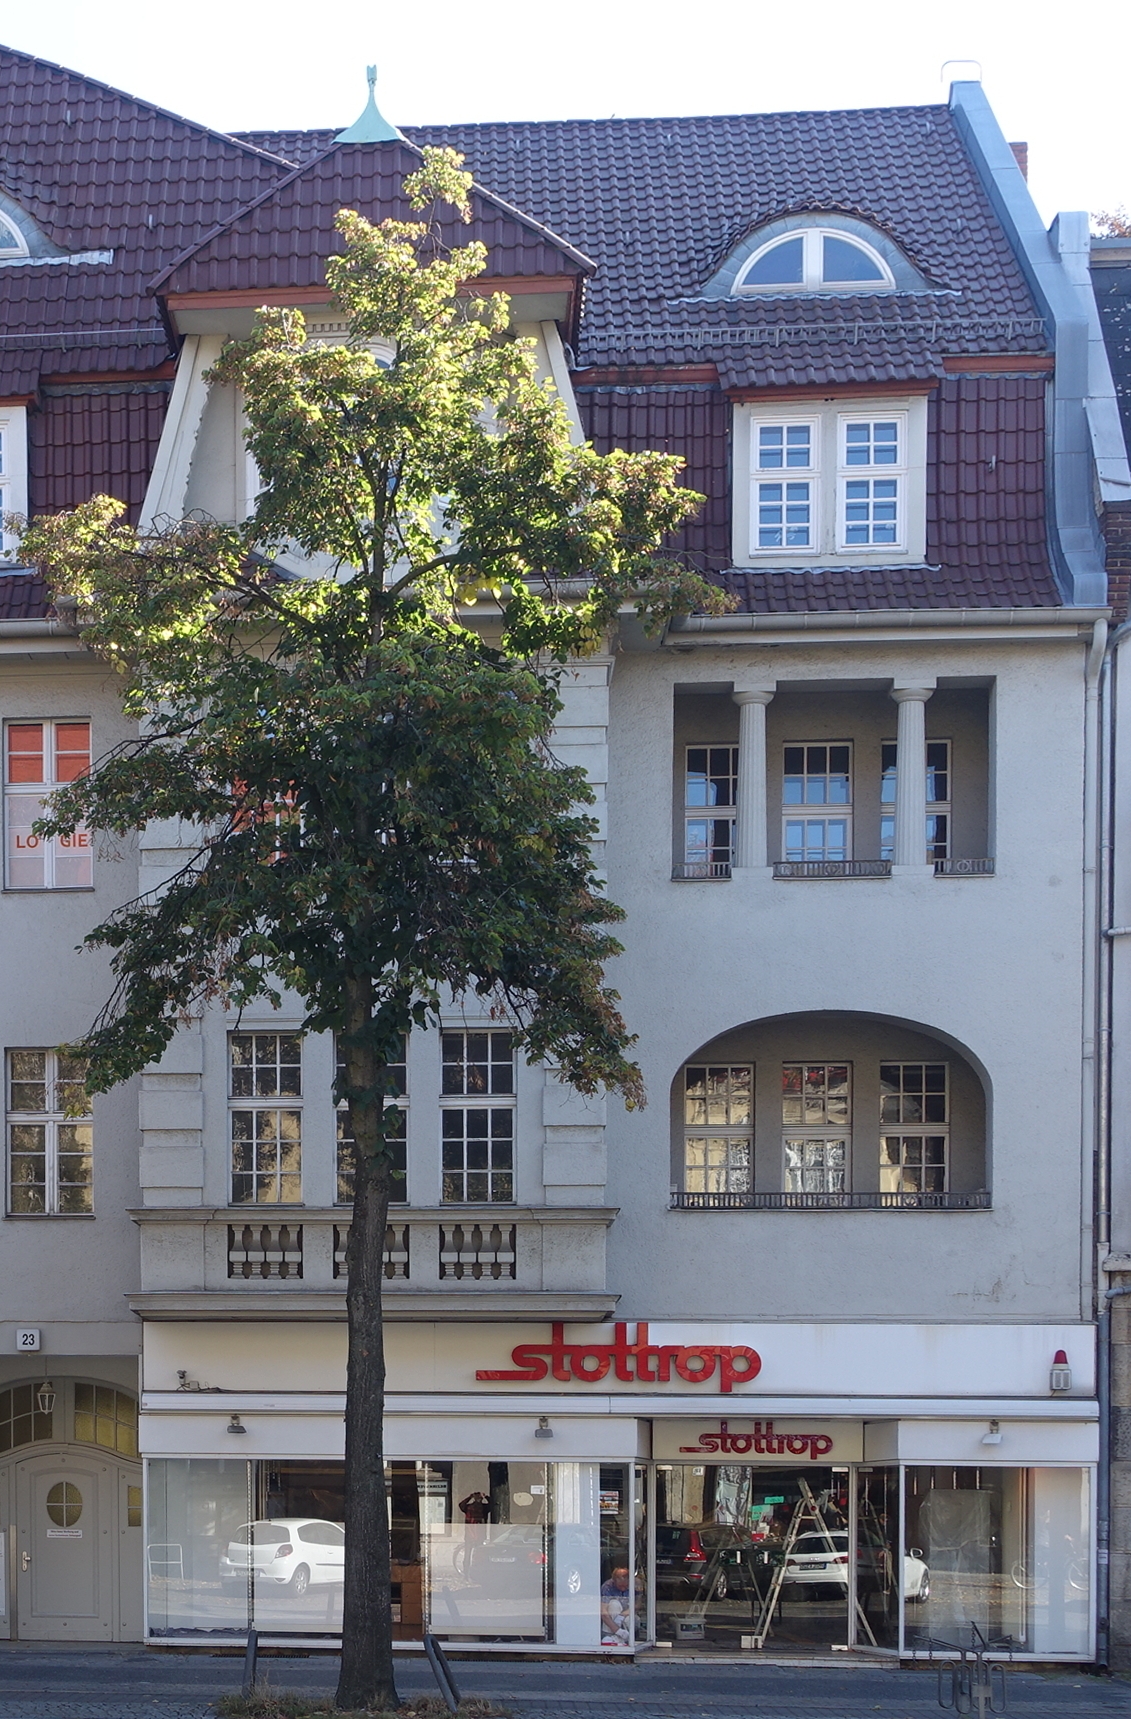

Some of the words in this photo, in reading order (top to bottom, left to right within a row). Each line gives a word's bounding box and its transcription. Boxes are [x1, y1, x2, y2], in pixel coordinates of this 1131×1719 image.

[15, 834, 40, 849] LO
[59, 833, 89, 848] GIE
[21, 1333, 36, 1346] 23
[475, 1322, 763, 1393] stottrop
[679, 1421, 834, 1460] stottrop
